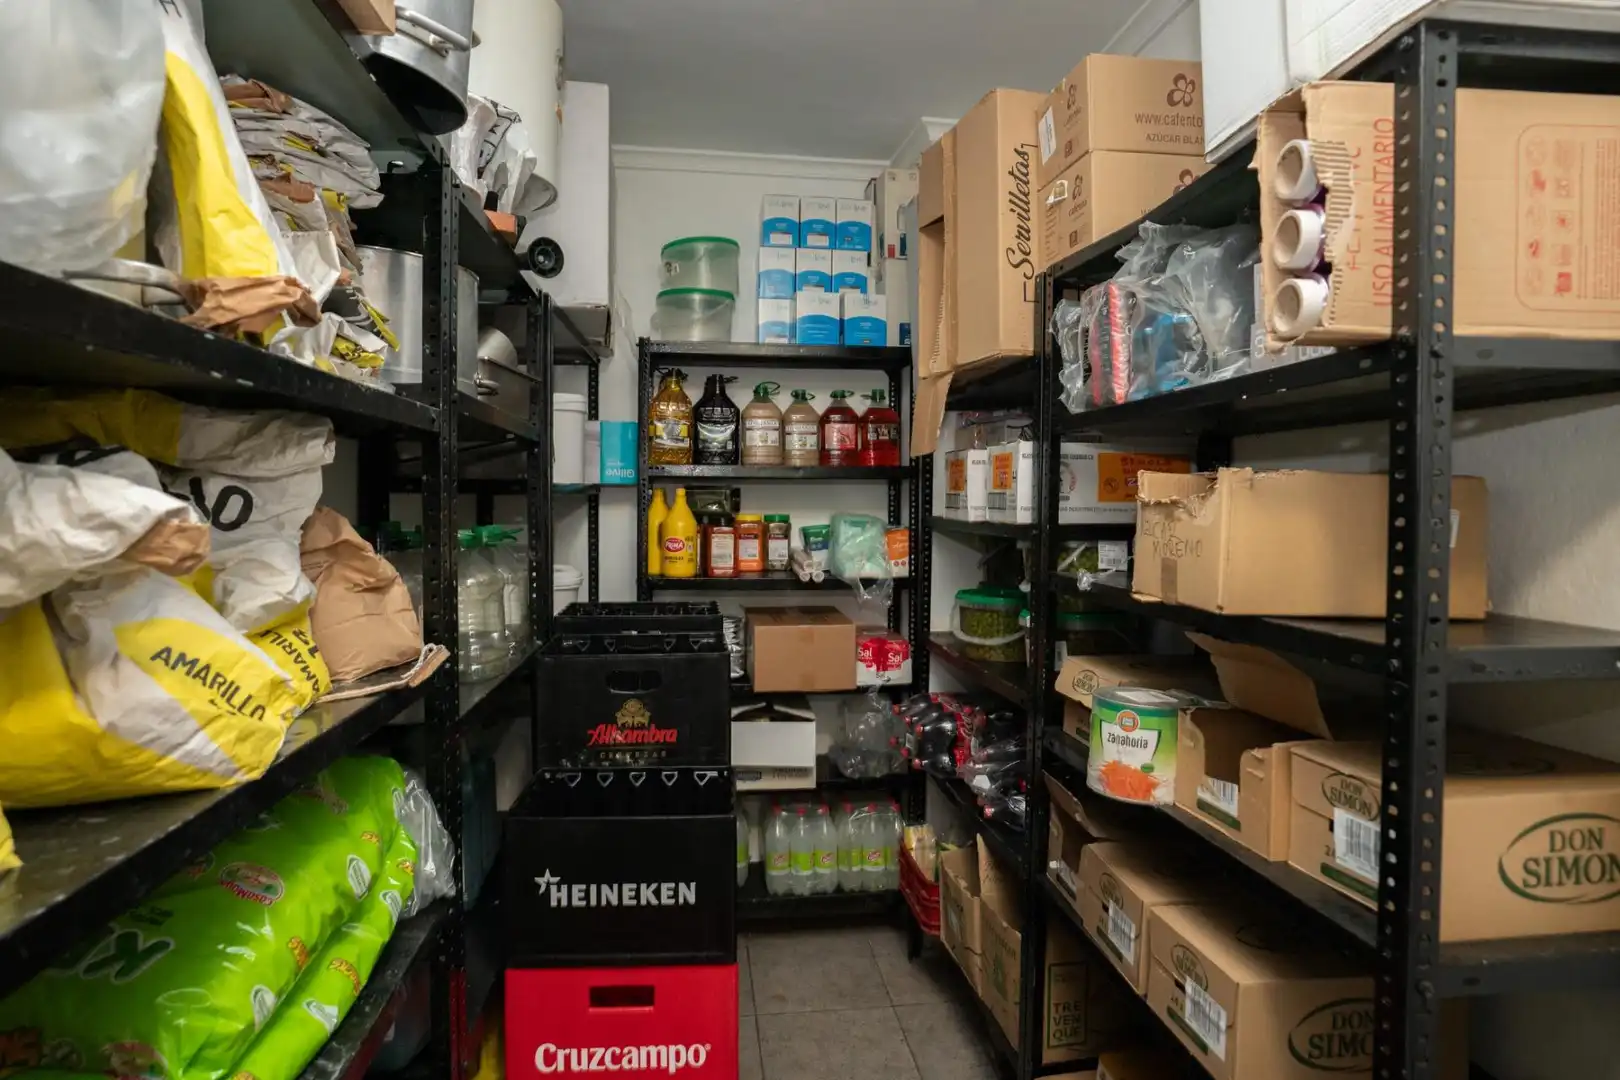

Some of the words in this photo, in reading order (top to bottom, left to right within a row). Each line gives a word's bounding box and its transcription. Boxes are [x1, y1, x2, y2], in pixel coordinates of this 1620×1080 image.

[1146, 132, 1181, 143] AZÚCAR
[1373, 117, 1395, 261] ALIMENTARIO
[1006, 147, 1035, 280] Servilletas
[1373, 264, 1394, 307] USO
[888, 652, 902, 662] Sal
[587, 723, 678, 746] Alhambra
[1107, 732, 1149, 749] zanahoria
[1549, 827, 1604, 853] DON
[550, 881, 697, 908] HEINEKEN
[534, 1042, 707, 1075] Cruzcampo
[1308, 1031, 1373, 1059] SIMO
